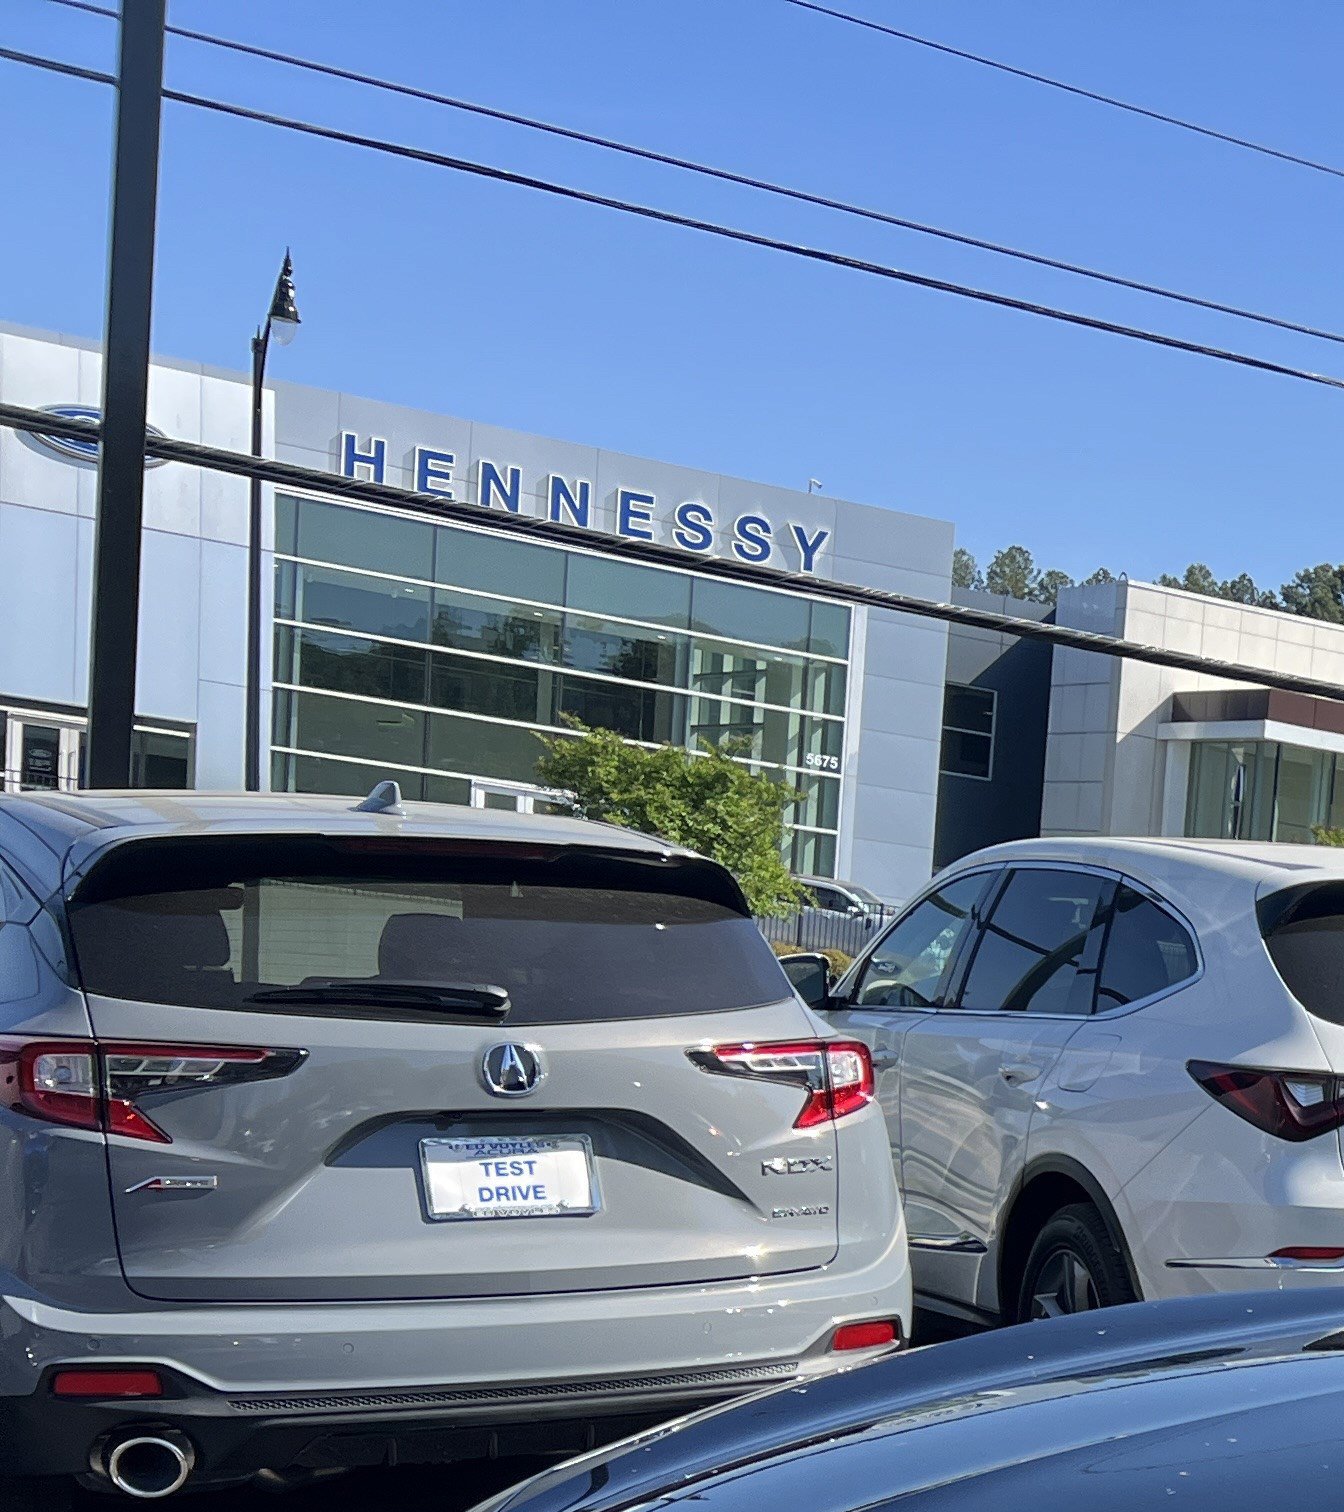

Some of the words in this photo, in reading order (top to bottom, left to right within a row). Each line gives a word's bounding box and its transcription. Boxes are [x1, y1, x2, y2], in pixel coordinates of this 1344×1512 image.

[341, 431, 830, 572] HENNESSY
[805, 752, 839, 769] 5675
[479, 1160, 538, 1177] TEST
[478, 1184, 547, 1202] DRIVE
